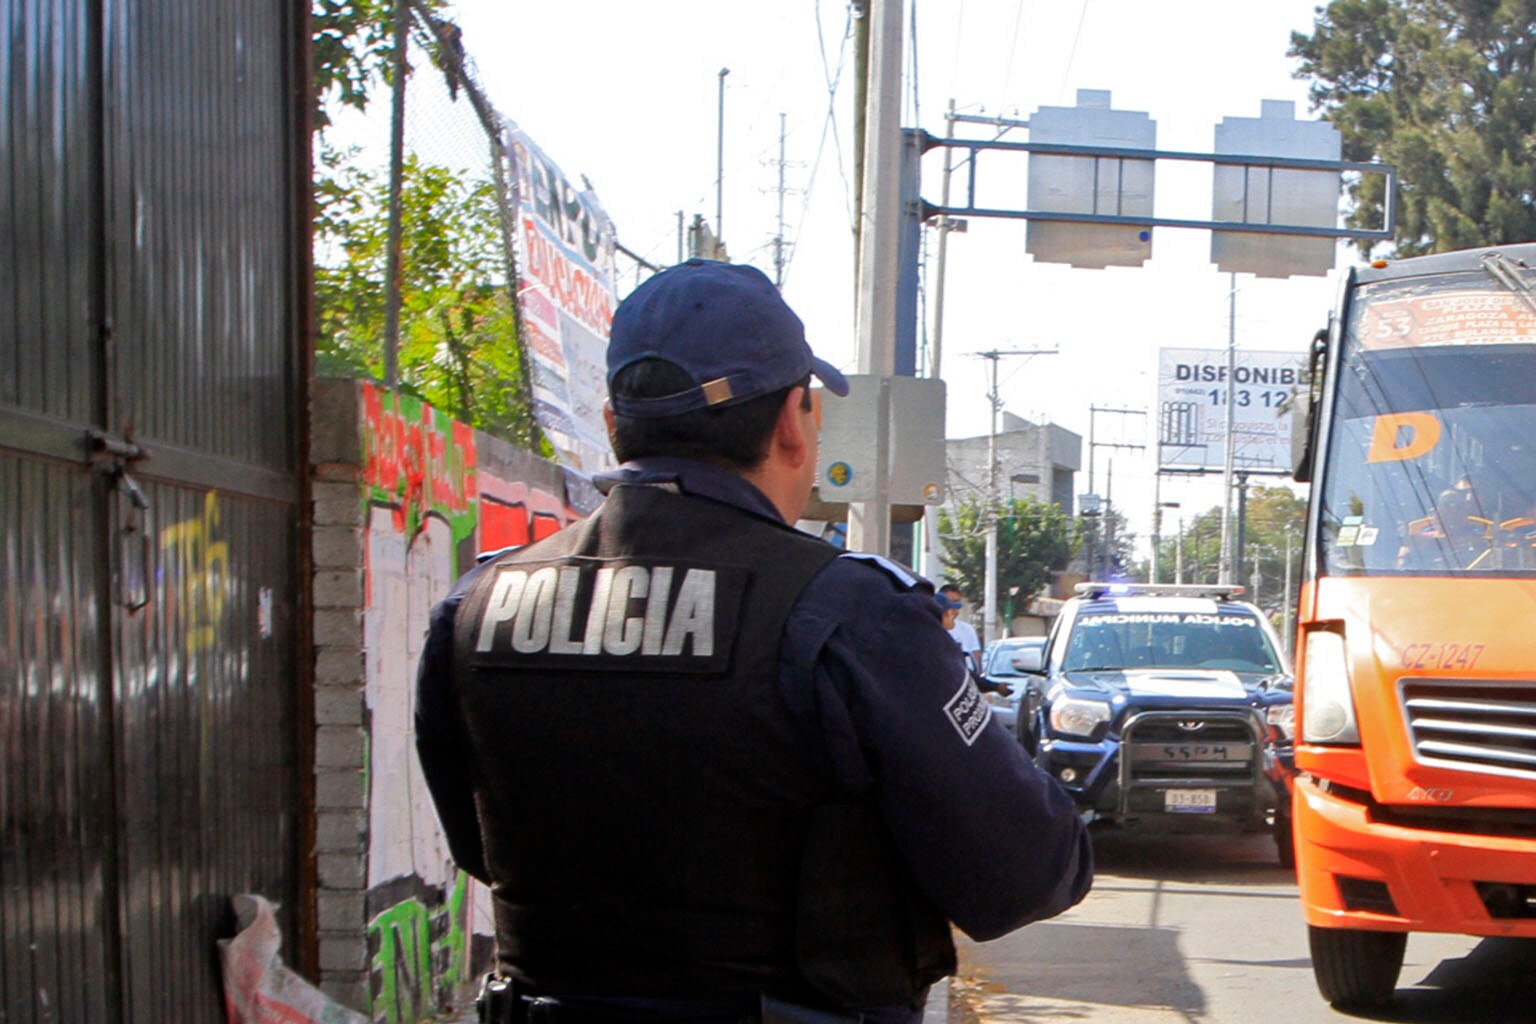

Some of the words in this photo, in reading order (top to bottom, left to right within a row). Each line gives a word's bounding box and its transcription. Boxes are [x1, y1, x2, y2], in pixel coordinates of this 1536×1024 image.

[1376, 316, 1410, 338] 53
[1175, 364, 1308, 385] DISPONIBL
[1367, 411, 1441, 463] D
[476, 566, 716, 656] POLICIA
